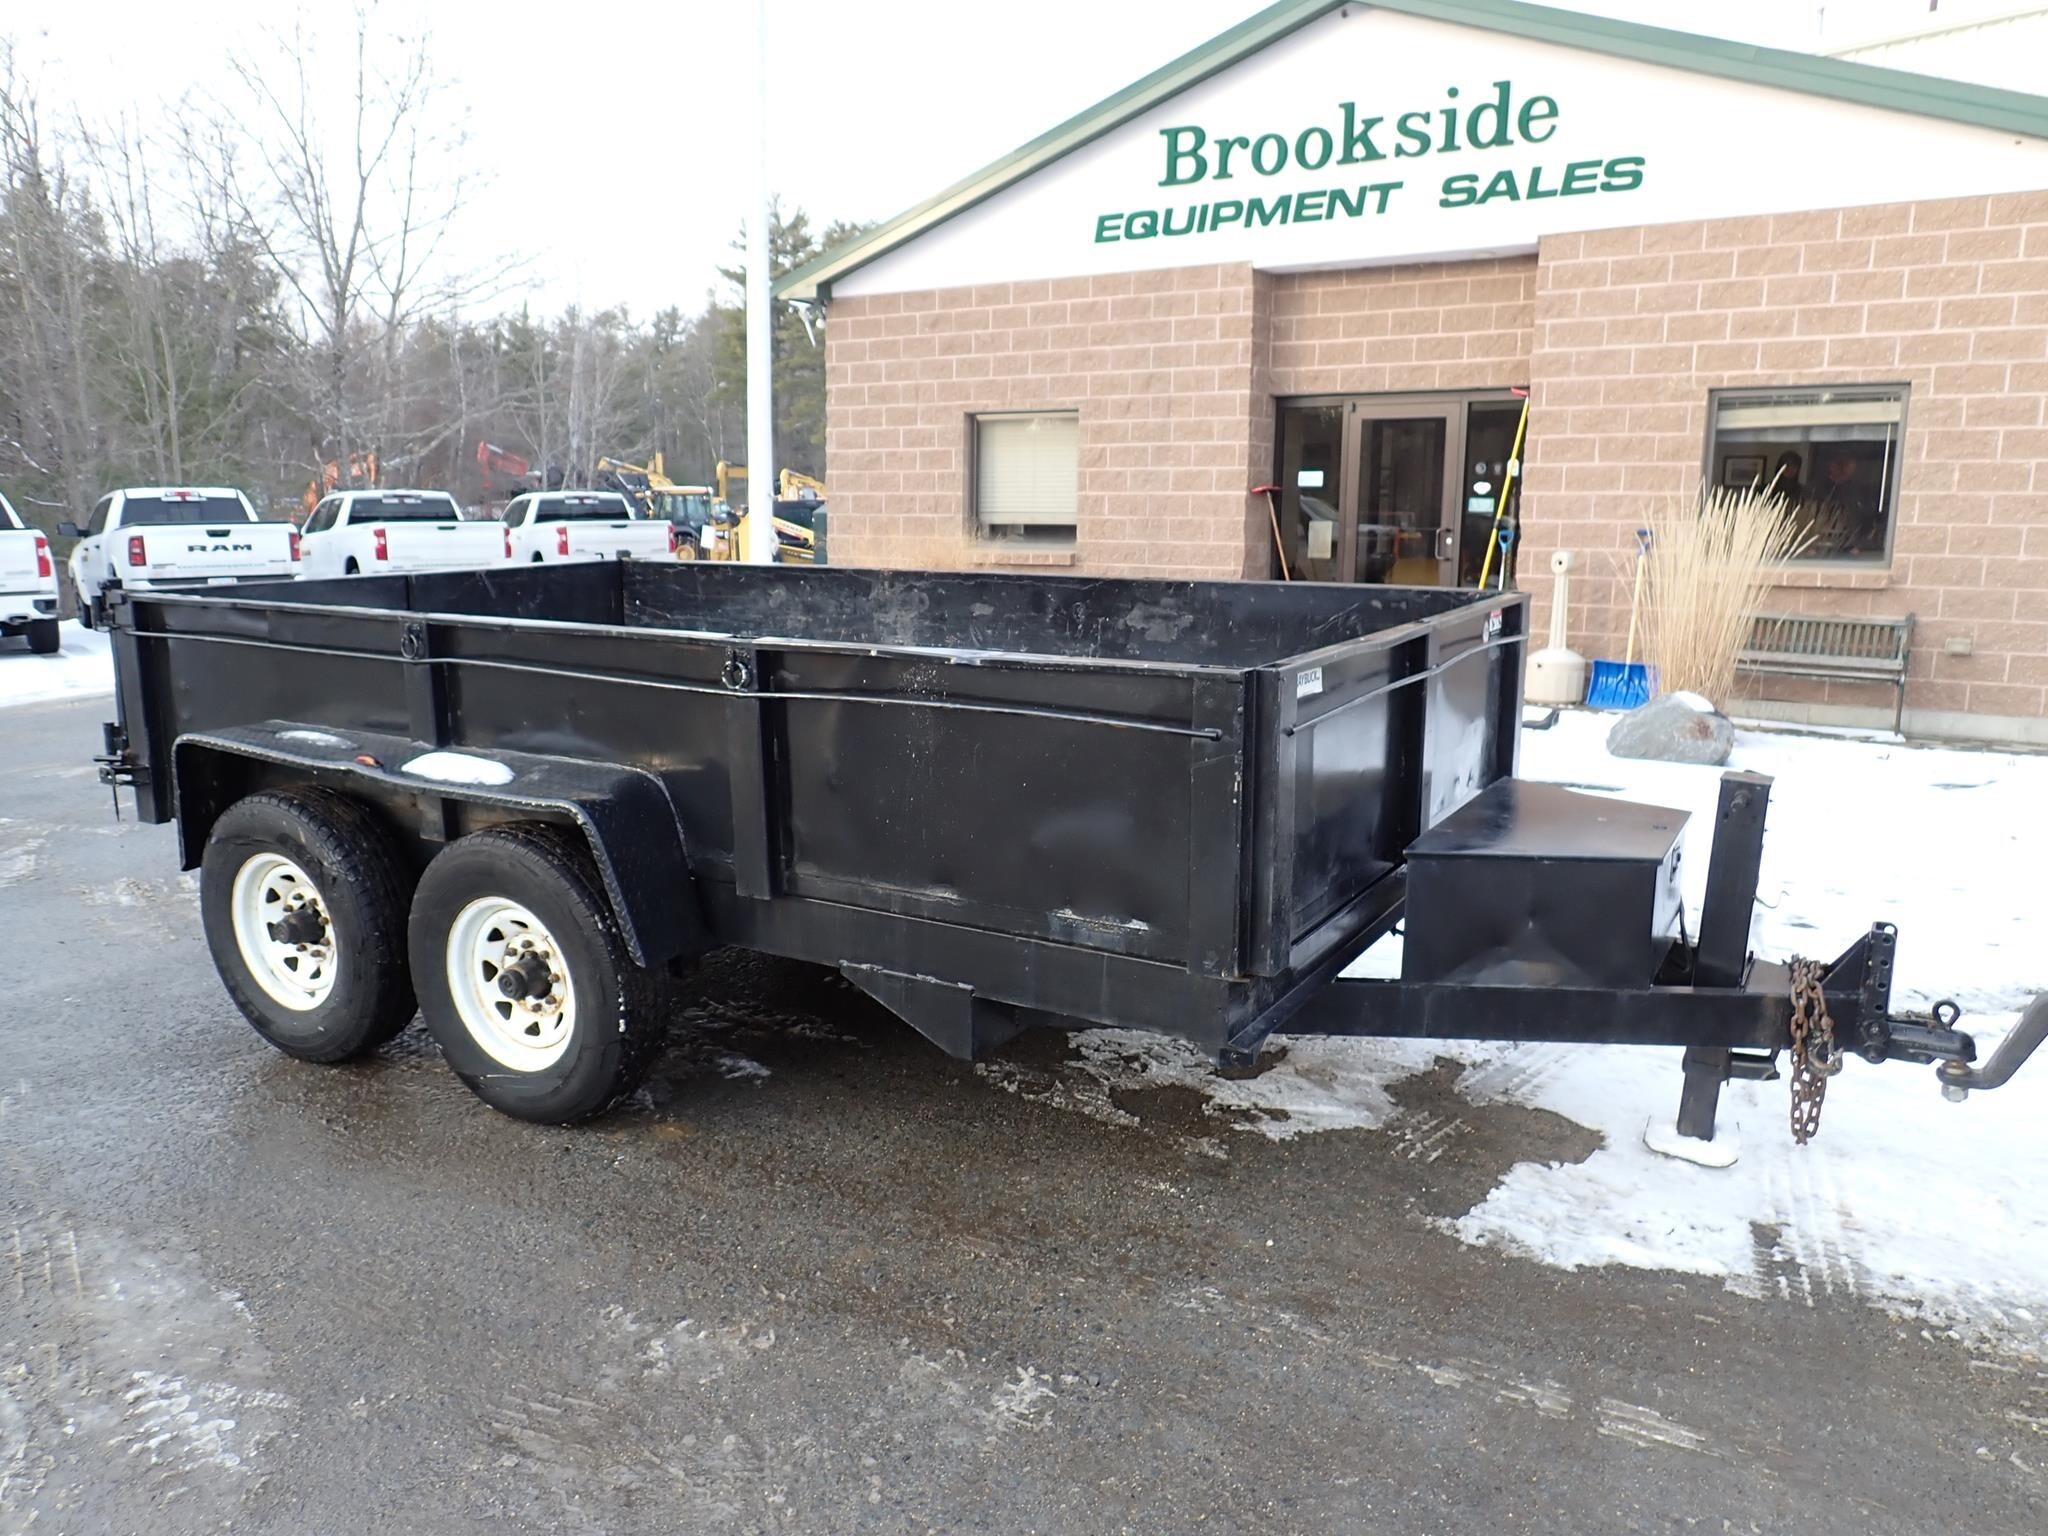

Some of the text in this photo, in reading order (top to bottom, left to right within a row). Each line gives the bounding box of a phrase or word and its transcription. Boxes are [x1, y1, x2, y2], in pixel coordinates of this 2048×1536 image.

[1157, 79, 1559, 187] Brookside
[1094, 155, 1646, 243] EQUIPMENT SALES
[187, 543, 253, 553] RAM
